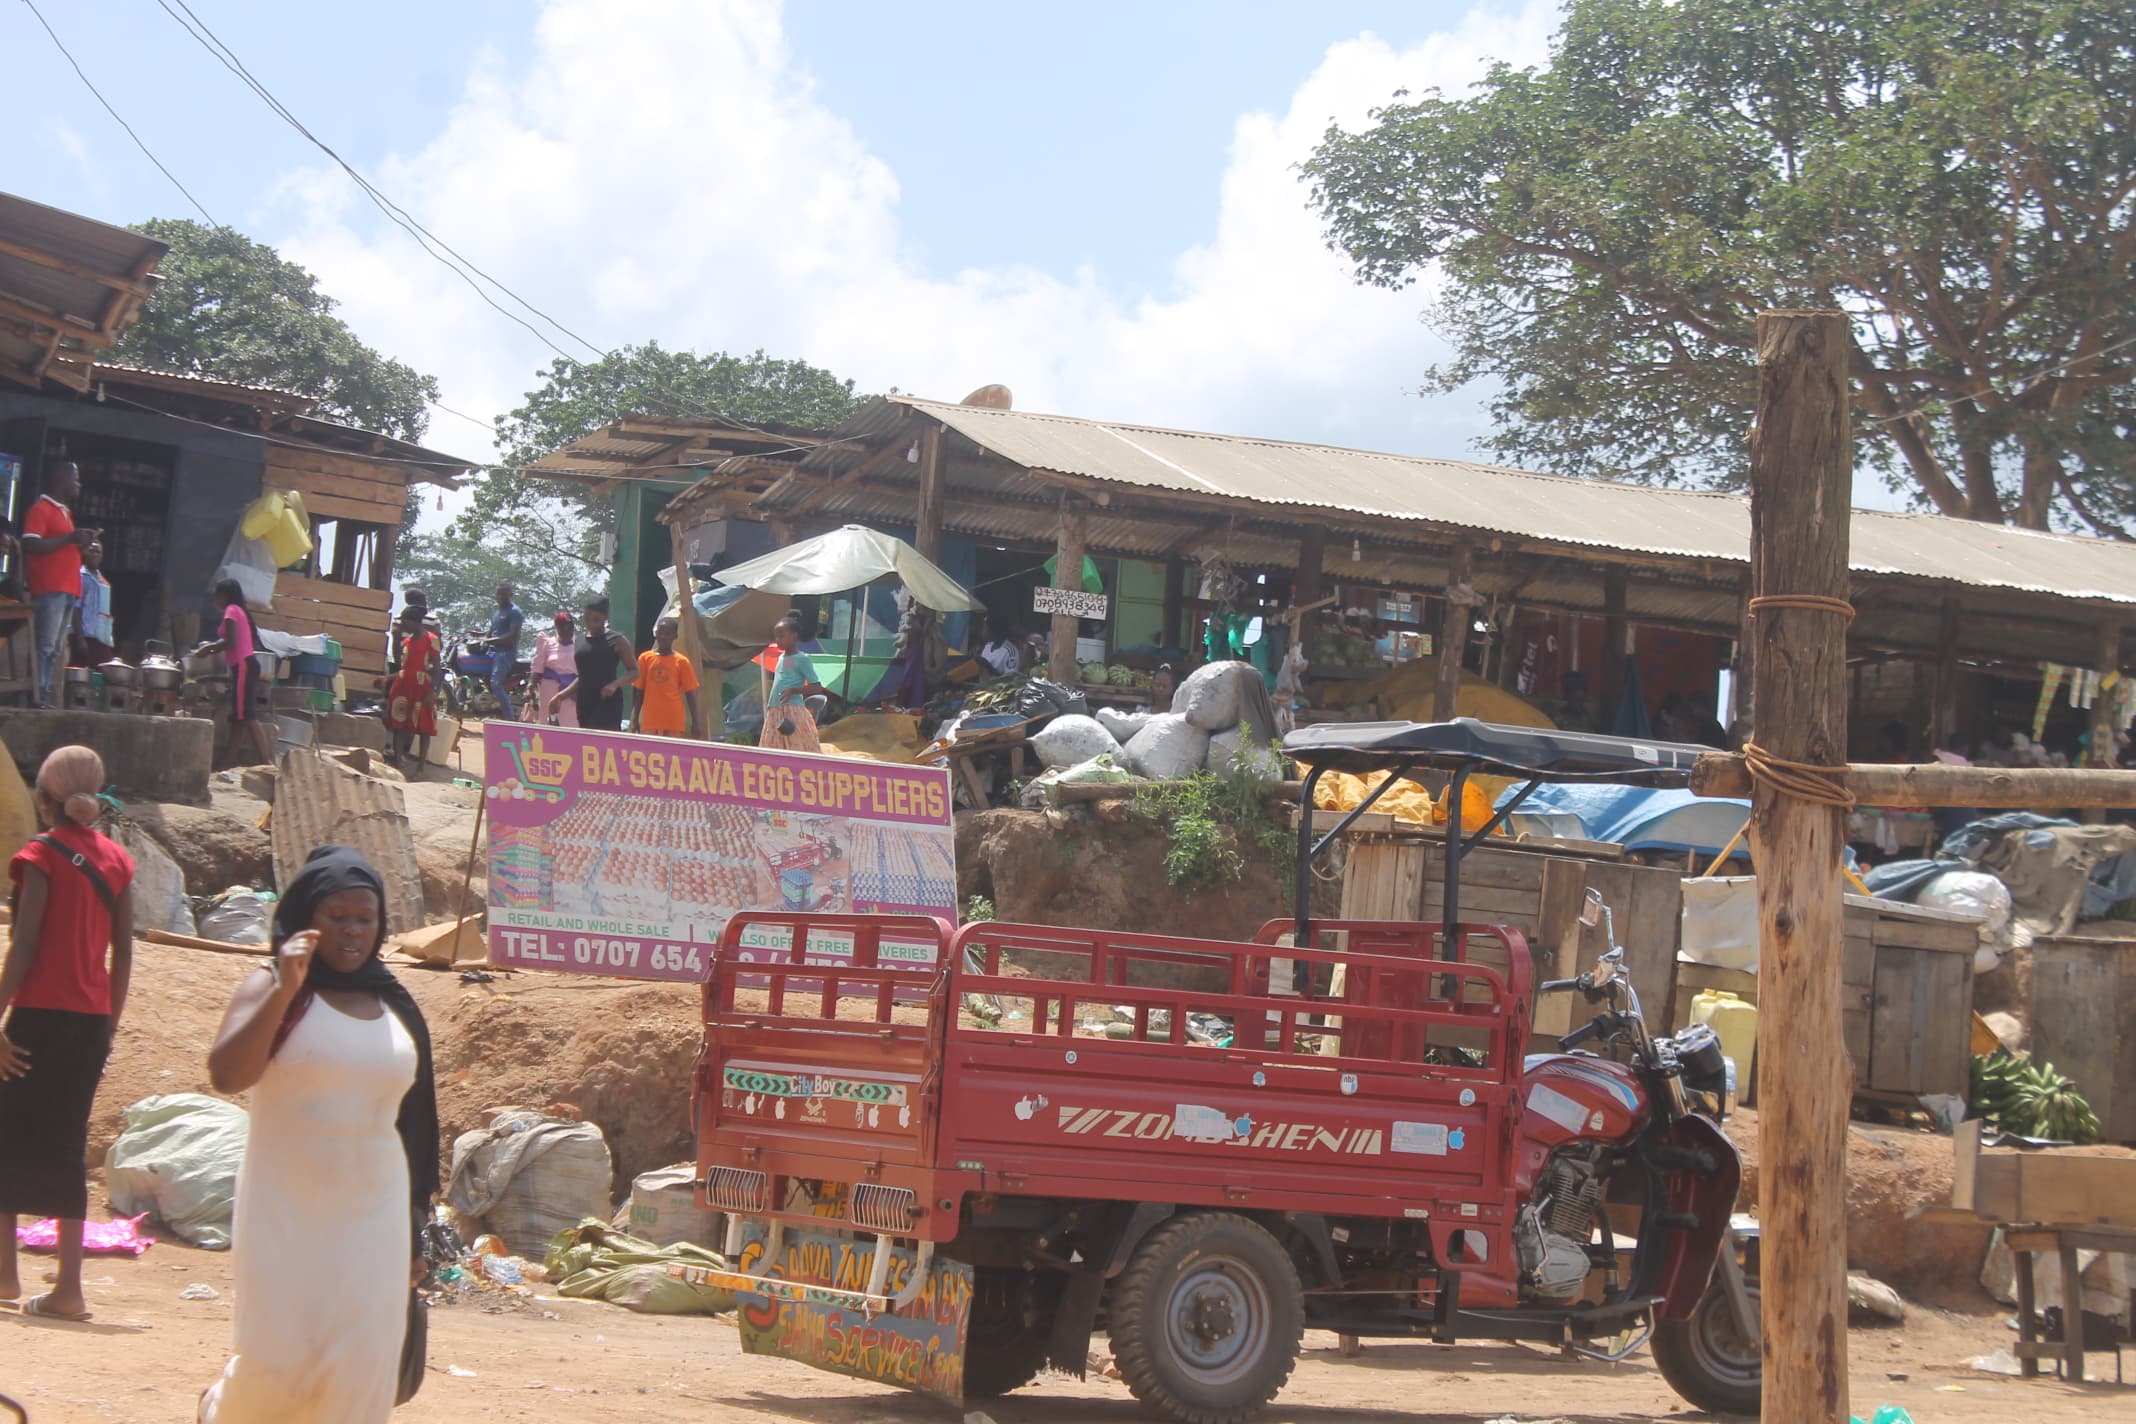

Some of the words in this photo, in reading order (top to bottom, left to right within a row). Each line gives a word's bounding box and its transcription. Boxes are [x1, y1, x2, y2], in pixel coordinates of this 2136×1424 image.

[528, 758, 562, 779] SSC
[742, 763, 794, 803] EGG
[800, 769, 945, 818] SUPPLIERS
[508, 912, 552, 928] RETAIL
[556, 916, 583, 930] AND
[588, 919, 634, 936] WHOLE
[637, 924, 669, 938] SALE
[501, 931, 565, 962] TEL:
[574, 938, 641, 968] 0707
[650, 944, 702, 973] 654
[817, 940, 850, 954] FREE
[790, 1075, 813, 1097] City
[814, 1075, 835, 1097] Boy
